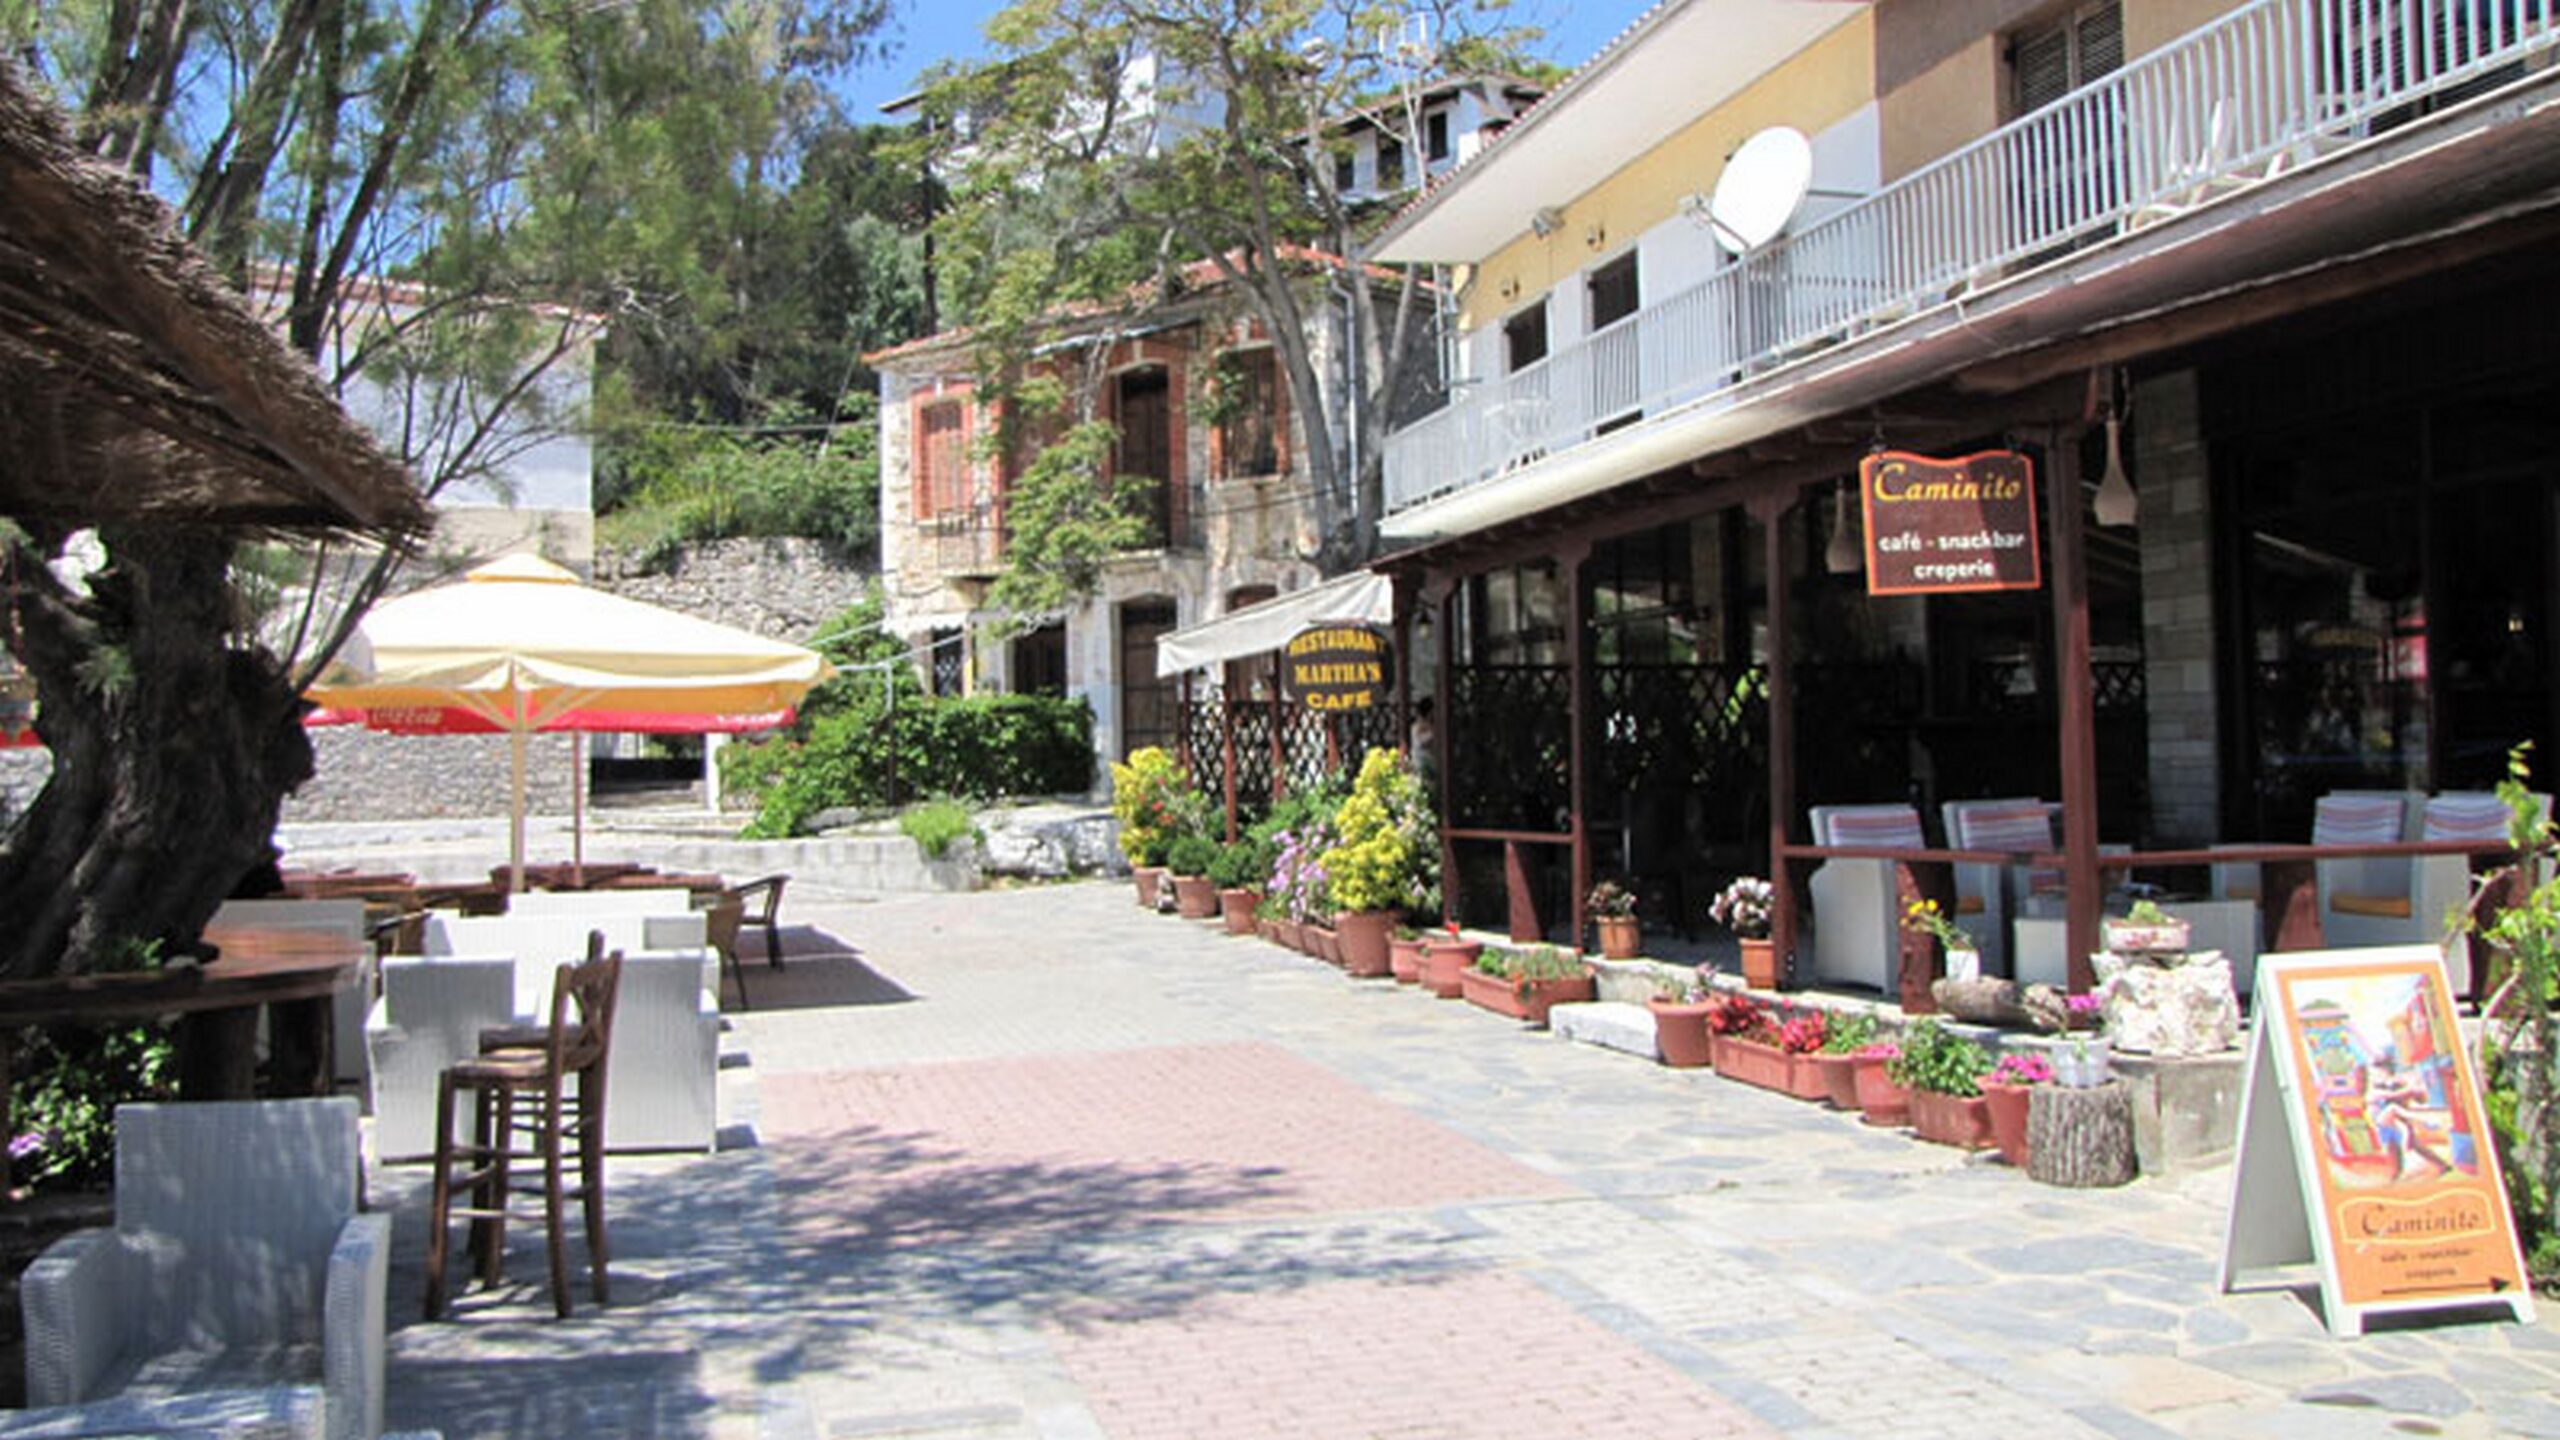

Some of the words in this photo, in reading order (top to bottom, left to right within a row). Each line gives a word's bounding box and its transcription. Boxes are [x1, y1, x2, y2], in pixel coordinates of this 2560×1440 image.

[1874, 462, 2021, 501] Caminito
[1878, 531, 1922, 551] café
[1938, 530, 2026, 550] snackbar
[1913, 559, 1995, 582] creperie
[1288, 628, 1386, 657] RESTAURANT
[1294, 663, 1382, 686] MARTHA'S
[2361, 1202, 2480, 1236] Caminito
